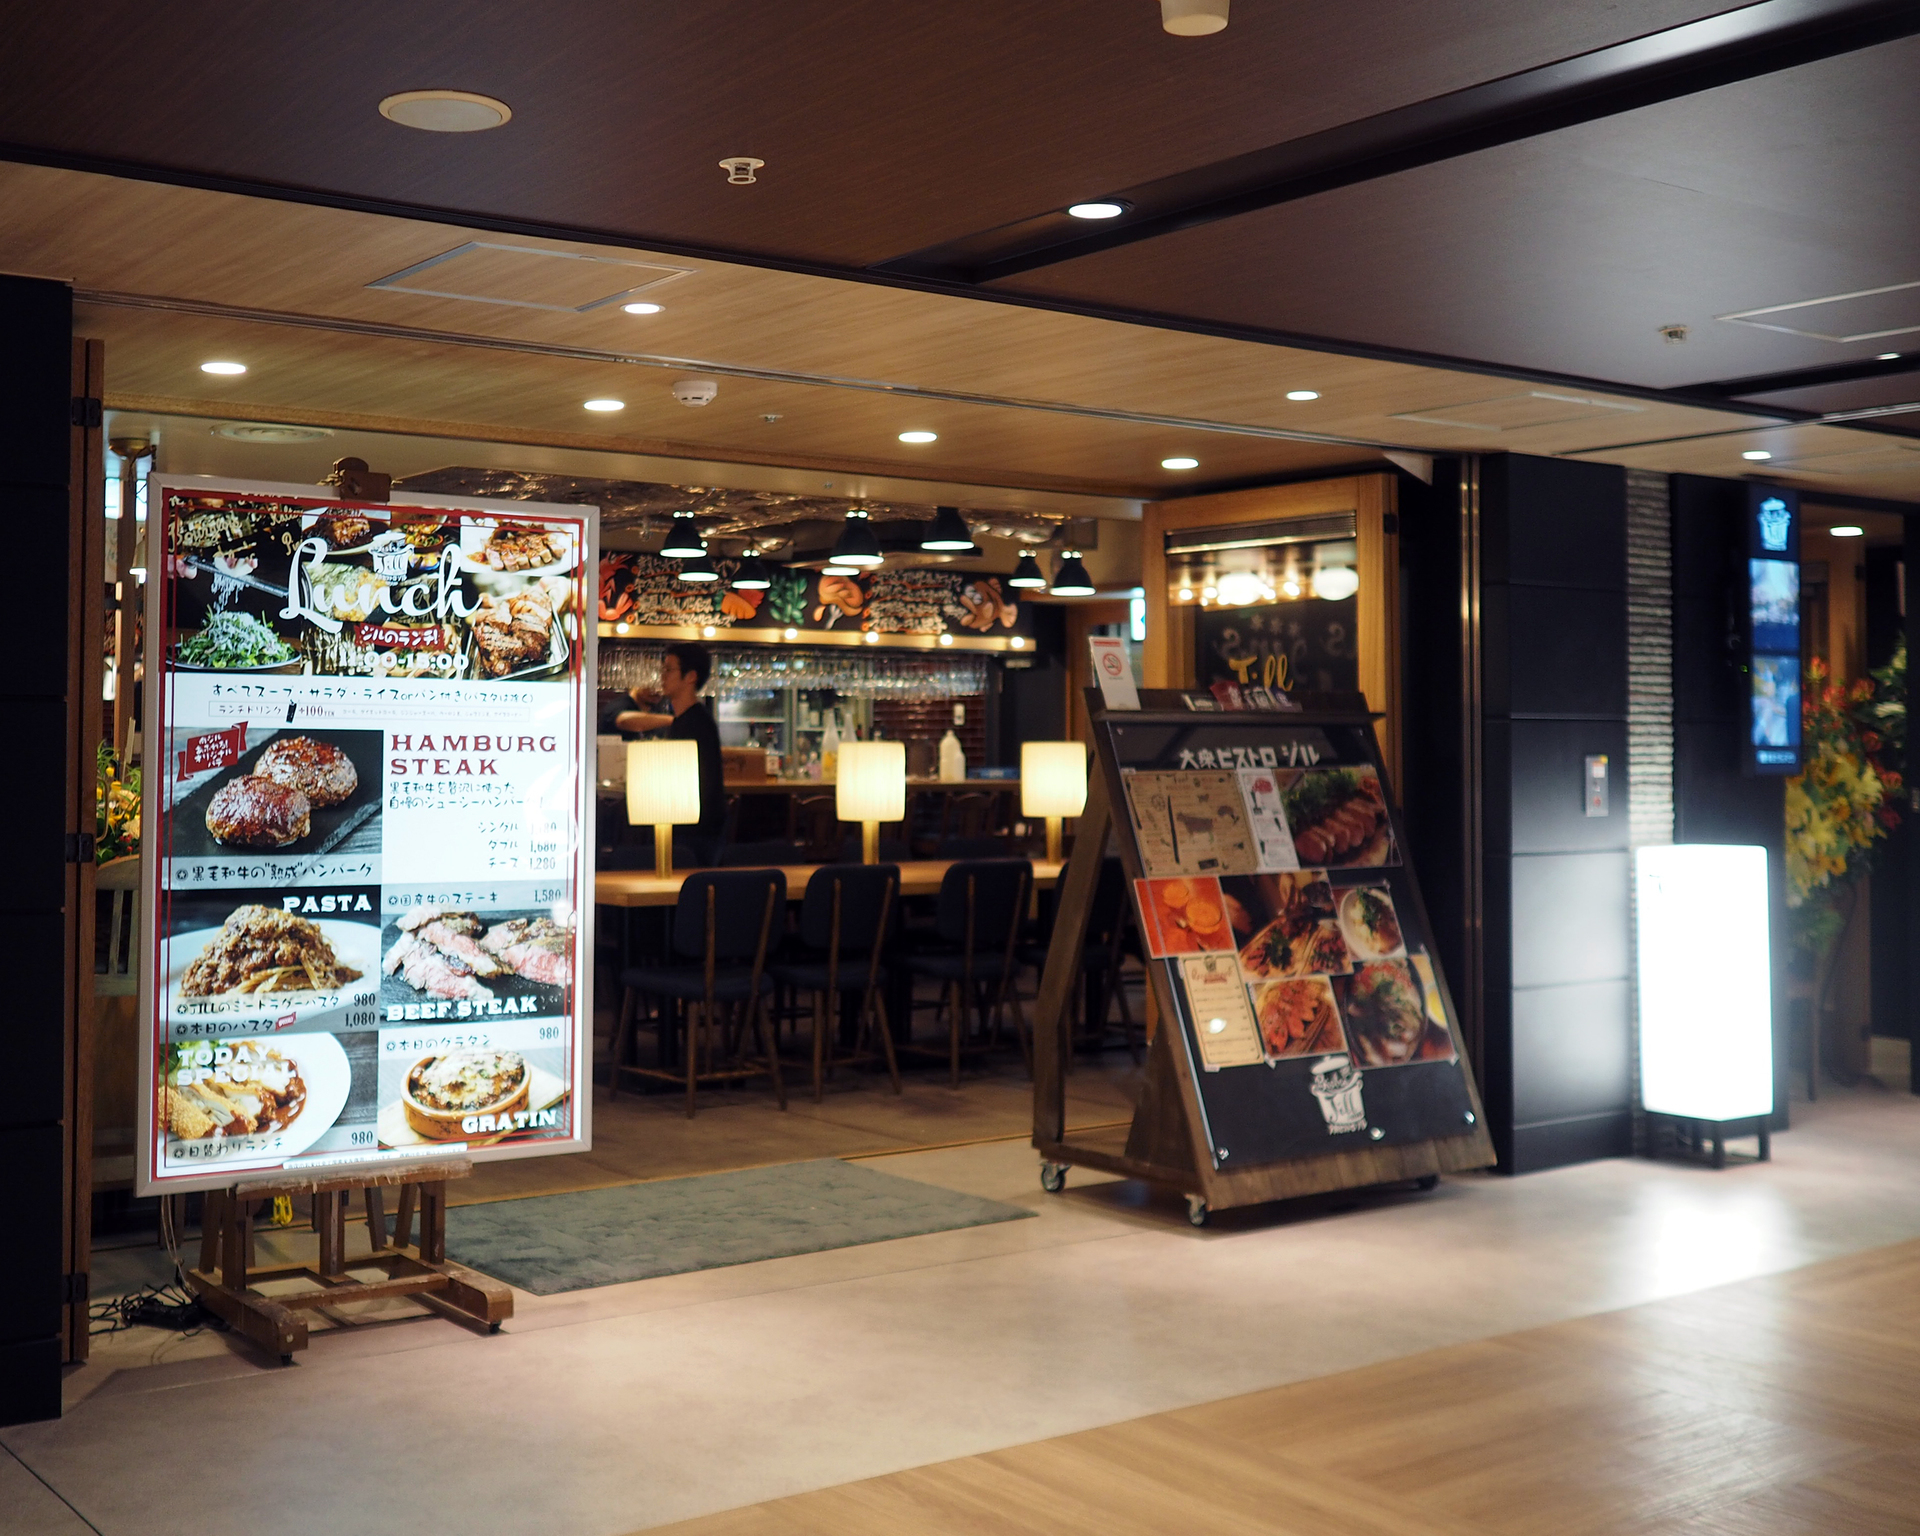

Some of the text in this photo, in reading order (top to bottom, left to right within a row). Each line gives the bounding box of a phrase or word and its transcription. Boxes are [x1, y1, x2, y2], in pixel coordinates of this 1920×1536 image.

[279, 537, 483, 634] Lunch
[360, 625, 439, 646] ジルのランチ!
[391, 734, 557, 753] HAMBURG
[391, 758, 499, 776] STEAK
[282, 894, 372, 914] PASTA
[534, 889, 561, 904] 1,580
[353, 992, 376, 1008] 980
[386, 995, 538, 1022] BEEF STEAK
[190, 1018, 274, 1034] 本日のパスタ
[344, 1012, 376, 1028] 1,080
[399, 1026, 559, 1050] 本日のグラタン 980
[177, 1045, 272, 1067] TODAY
[461, 1110, 557, 1134] GRATIN
[351, 1131, 373, 1145] 980
